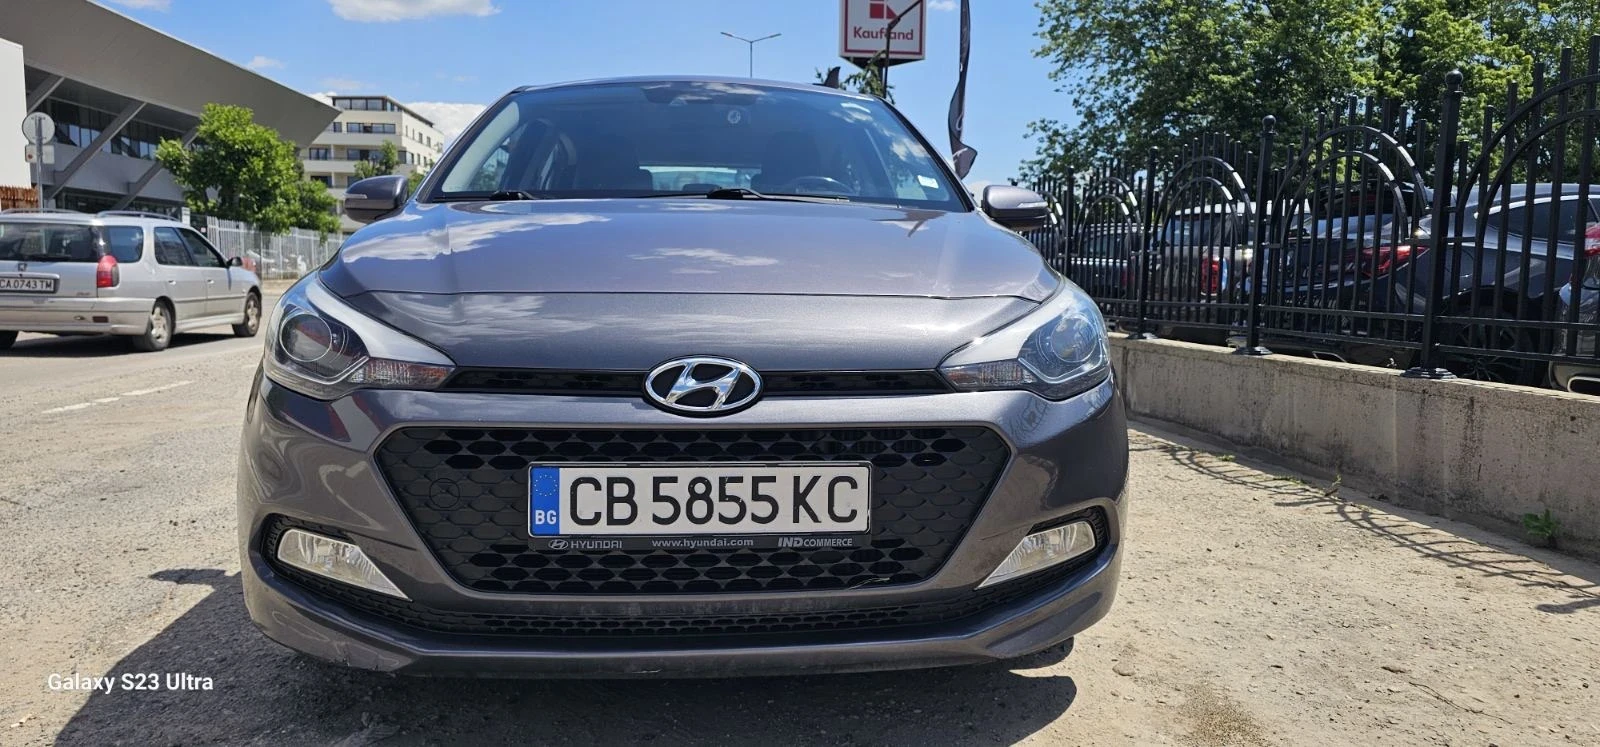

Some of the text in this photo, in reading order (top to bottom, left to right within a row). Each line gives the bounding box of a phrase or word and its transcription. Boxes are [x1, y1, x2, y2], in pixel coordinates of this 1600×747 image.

[853, 26, 914, 40] Kaufand
[13, 279, 37, 289] 0743
[40, 280, 52, 289] TM
[570, 475, 858, 526] CB 5855 KC
[535, 510, 557, 525] BG
[570, 541, 623, 549] HYUNDAI
[652, 539, 754, 549] www.hyundai.com
